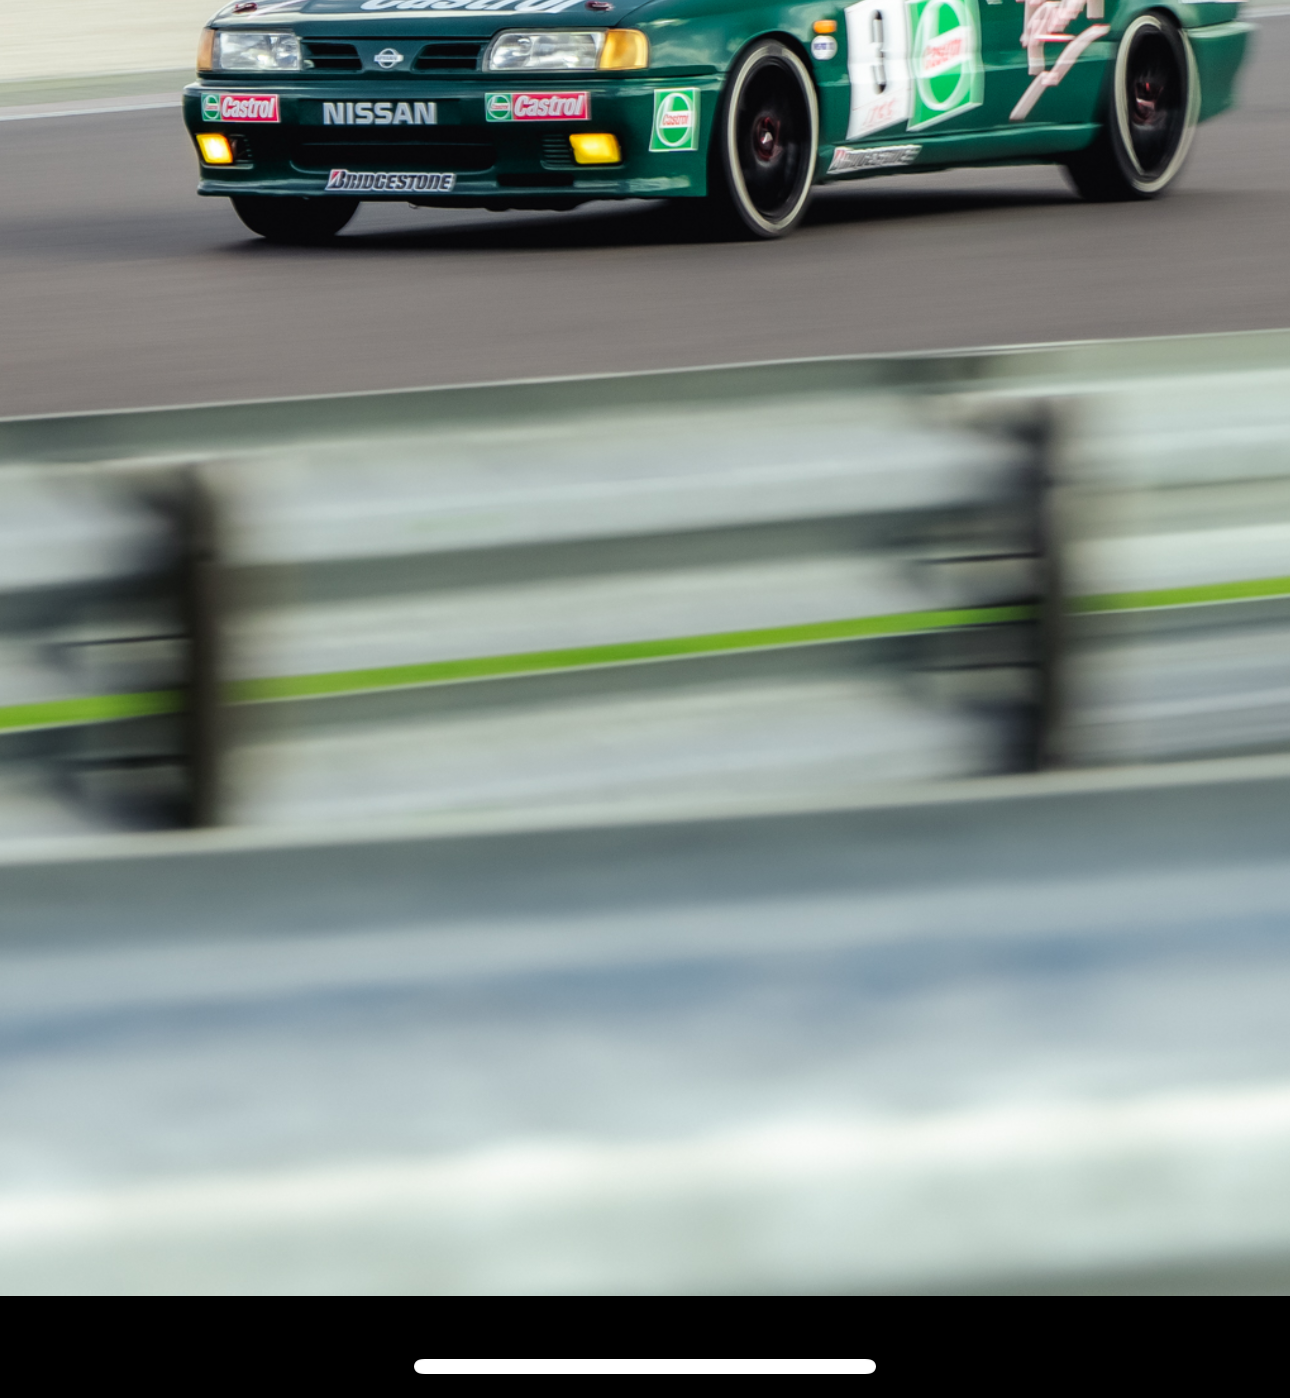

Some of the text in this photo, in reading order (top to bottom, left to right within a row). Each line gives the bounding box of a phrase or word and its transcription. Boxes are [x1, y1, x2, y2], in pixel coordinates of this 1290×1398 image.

[221, 95, 276, 118] Castrol
[323, 102, 437, 124] NISSAN
[514, 95, 585, 116] Castrol
[661, 111, 690, 126] Castrol
[327, 169, 453, 190] BRIDGESTONE
